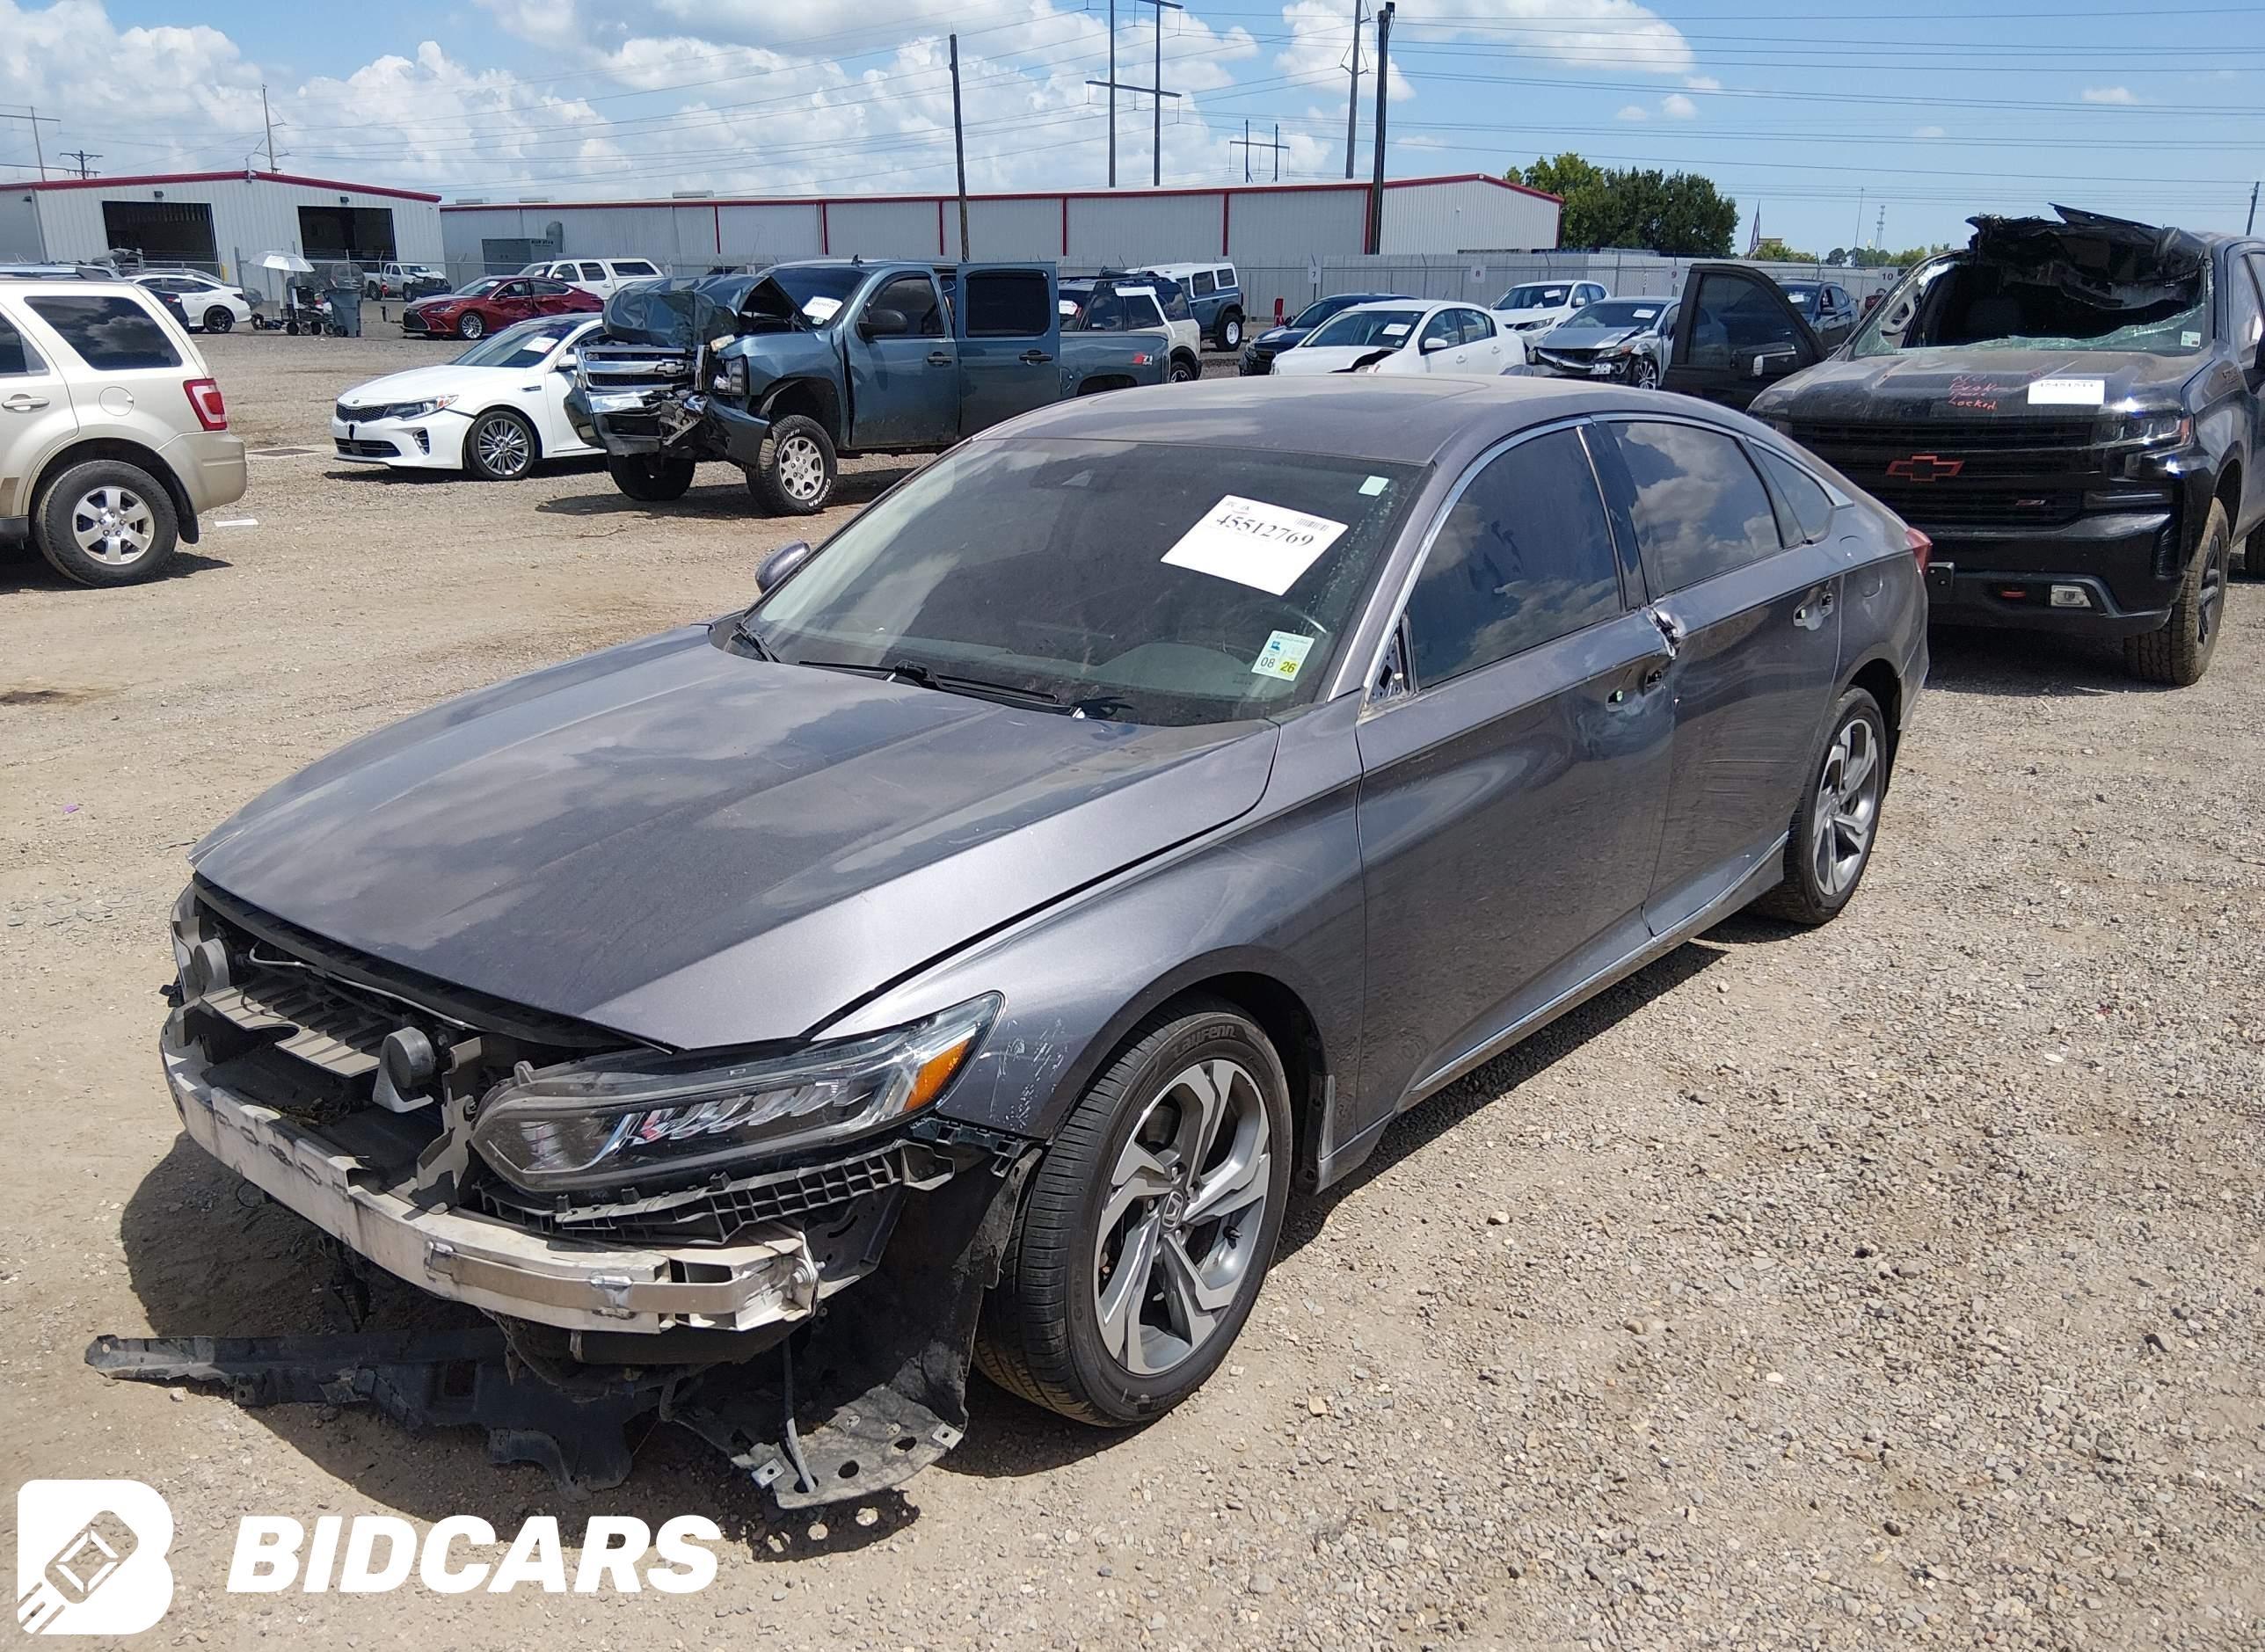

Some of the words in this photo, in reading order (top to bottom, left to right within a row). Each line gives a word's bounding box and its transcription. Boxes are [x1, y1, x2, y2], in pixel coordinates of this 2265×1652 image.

[1882, 272, 1894, 281] 10
[808, 477, 832, 507] COOPER
[1216, 513, 1315, 547] 45512769
[1260, 657, 1276, 668] 08
[1279, 661, 1297, 673] 26
